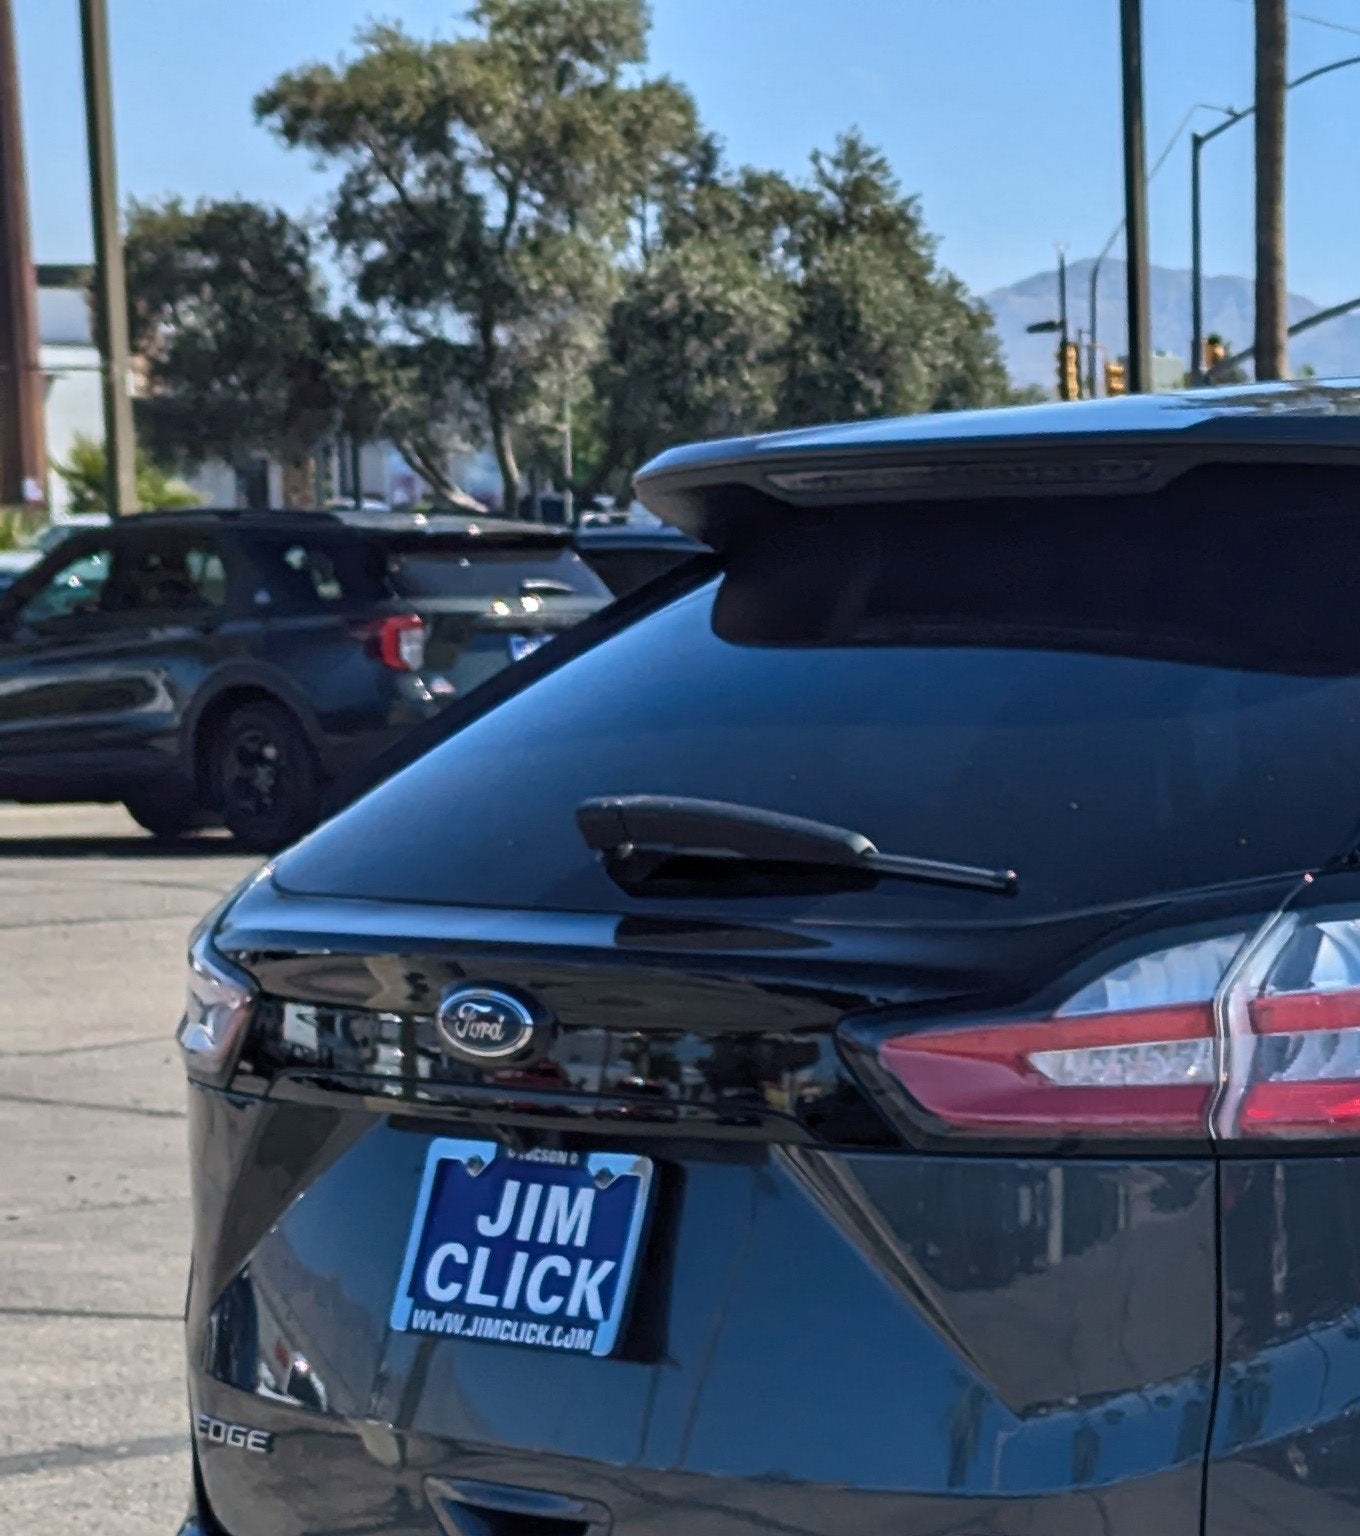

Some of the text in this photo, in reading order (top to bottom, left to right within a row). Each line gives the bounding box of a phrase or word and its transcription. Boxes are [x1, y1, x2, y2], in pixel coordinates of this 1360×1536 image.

[455, 1002, 505, 1041] Ford
[519, 1148, 568, 1165] UCSON
[477, 1179, 596, 1247] JIM
[424, 1242, 616, 1320] CLICK
[411, 1309, 594, 1350] WWW.JIMCLICK.COM
[199, 1414, 270, 1453] EDGE
